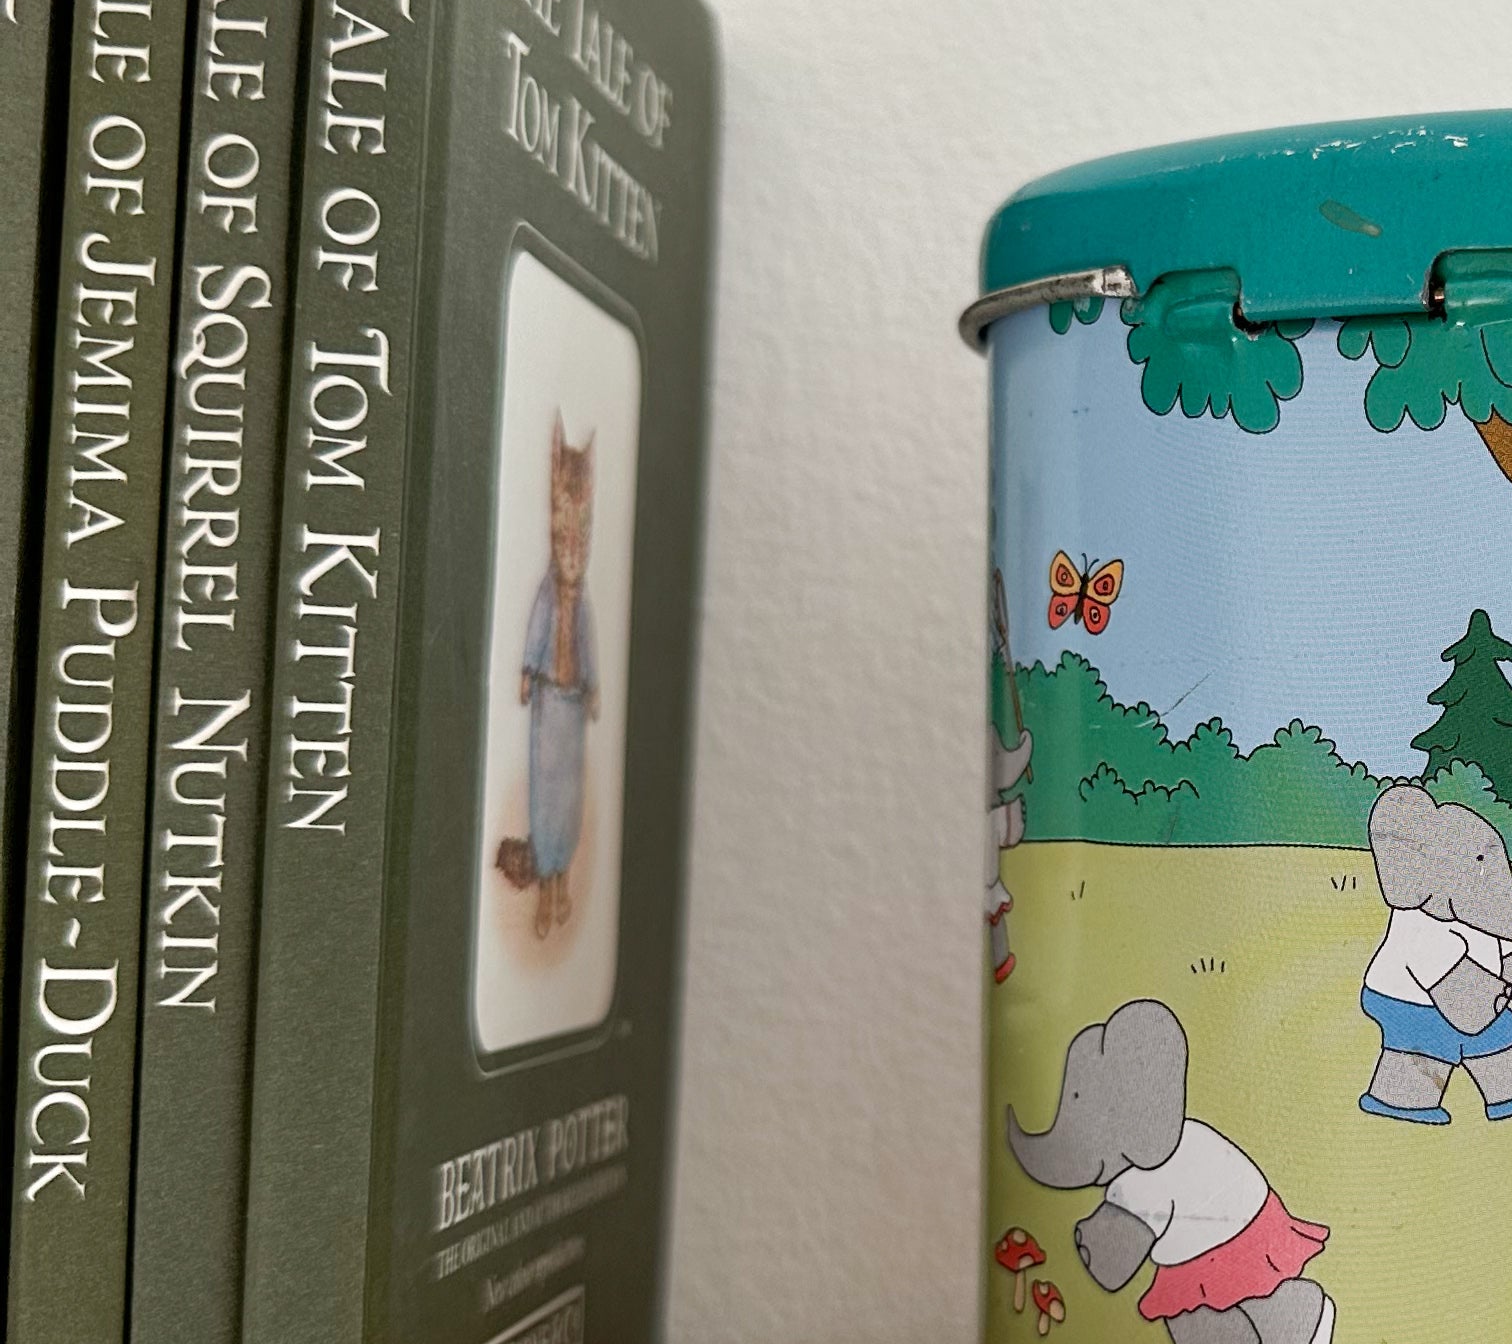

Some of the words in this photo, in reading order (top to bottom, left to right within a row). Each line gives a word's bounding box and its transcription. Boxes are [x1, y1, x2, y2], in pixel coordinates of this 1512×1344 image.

[85, 116, 145, 215] OF
[199, 134, 259, 233] OF
[499, 31, 561, 177] TOM
[558, 96, 661, 264] KITTEN
[636, 69, 673, 149] OF
[317, 188, 380, 291] OF
[65, 233, 156, 548] JEMIMA
[175, 266, 272, 650] SQUIRREL
[305, 329, 391, 490] TOM
[285, 524, 380, 834] KITTEN
[157, 688, 250, 1012] NUTKIN
[436, 1127, 539, 1232] BEATRIX
[550, 1094, 628, 1182] POTTER
